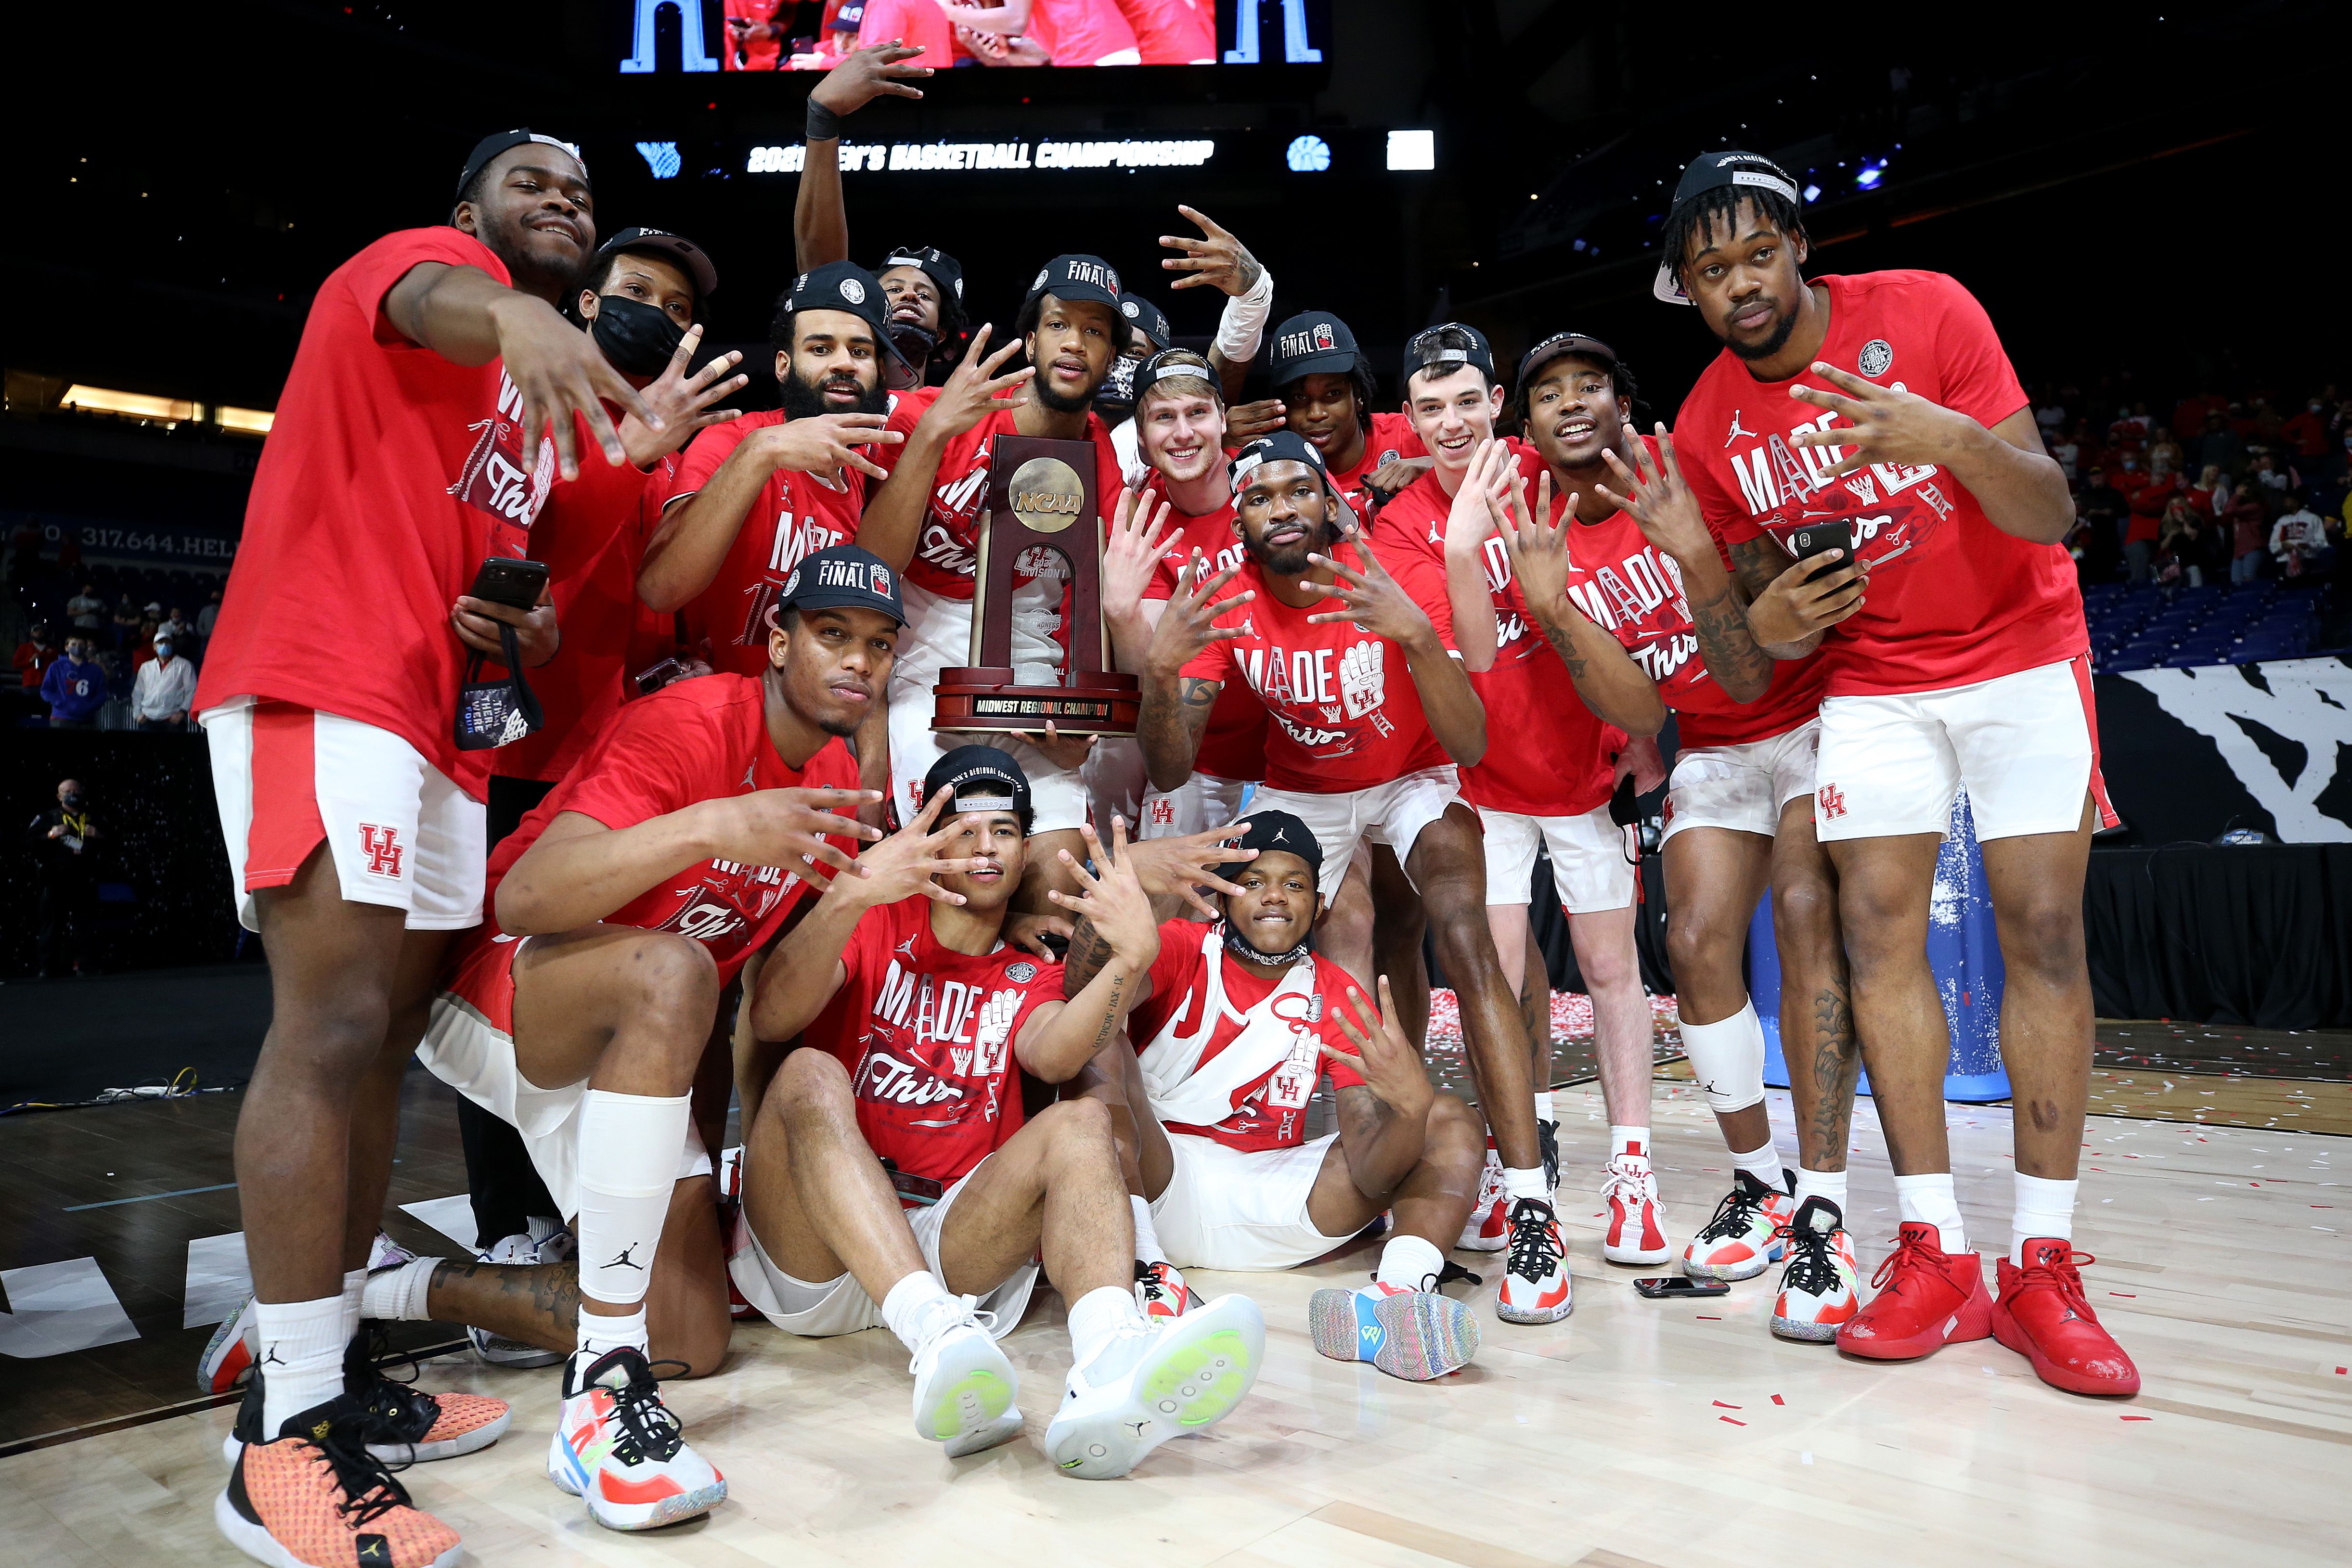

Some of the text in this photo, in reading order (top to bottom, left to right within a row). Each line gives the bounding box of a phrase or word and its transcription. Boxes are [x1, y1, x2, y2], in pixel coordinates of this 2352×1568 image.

[747, 140, 1214, 172] 2021 EN'S BASKETBALL CHAMPIONSHIP
[1068, 264, 1106, 288] FINAL
[1281, 335, 1314, 359] FINAL
[1864, 347, 1884, 361] FINAL
[1867, 355, 1886, 370] FOUR
[1016, 491, 1081, 514] NCAA
[82, 527, 240, 557] 317.644.HEL
[818, 565, 867, 590] FINAL
[1020, 568, 1060, 578] DIVISION
[1233, 646, 1336, 706] MADE
[977, 700, 1108, 716] MIDWEST REGIONAL CHAMPION
[1350, 687, 1376, 712] UH
[481, 695, 493, 730] THERE
[969, 767, 996, 776] REGIONAL
[1151, 799, 1175, 825] UH
[1819, 784, 1847, 821] UH
[360, 823, 403, 877] UH
[873, 958, 983, 1045] MADE
[870, 1053, 963, 1105] This
[1275, 1074, 1301, 1103] UH
